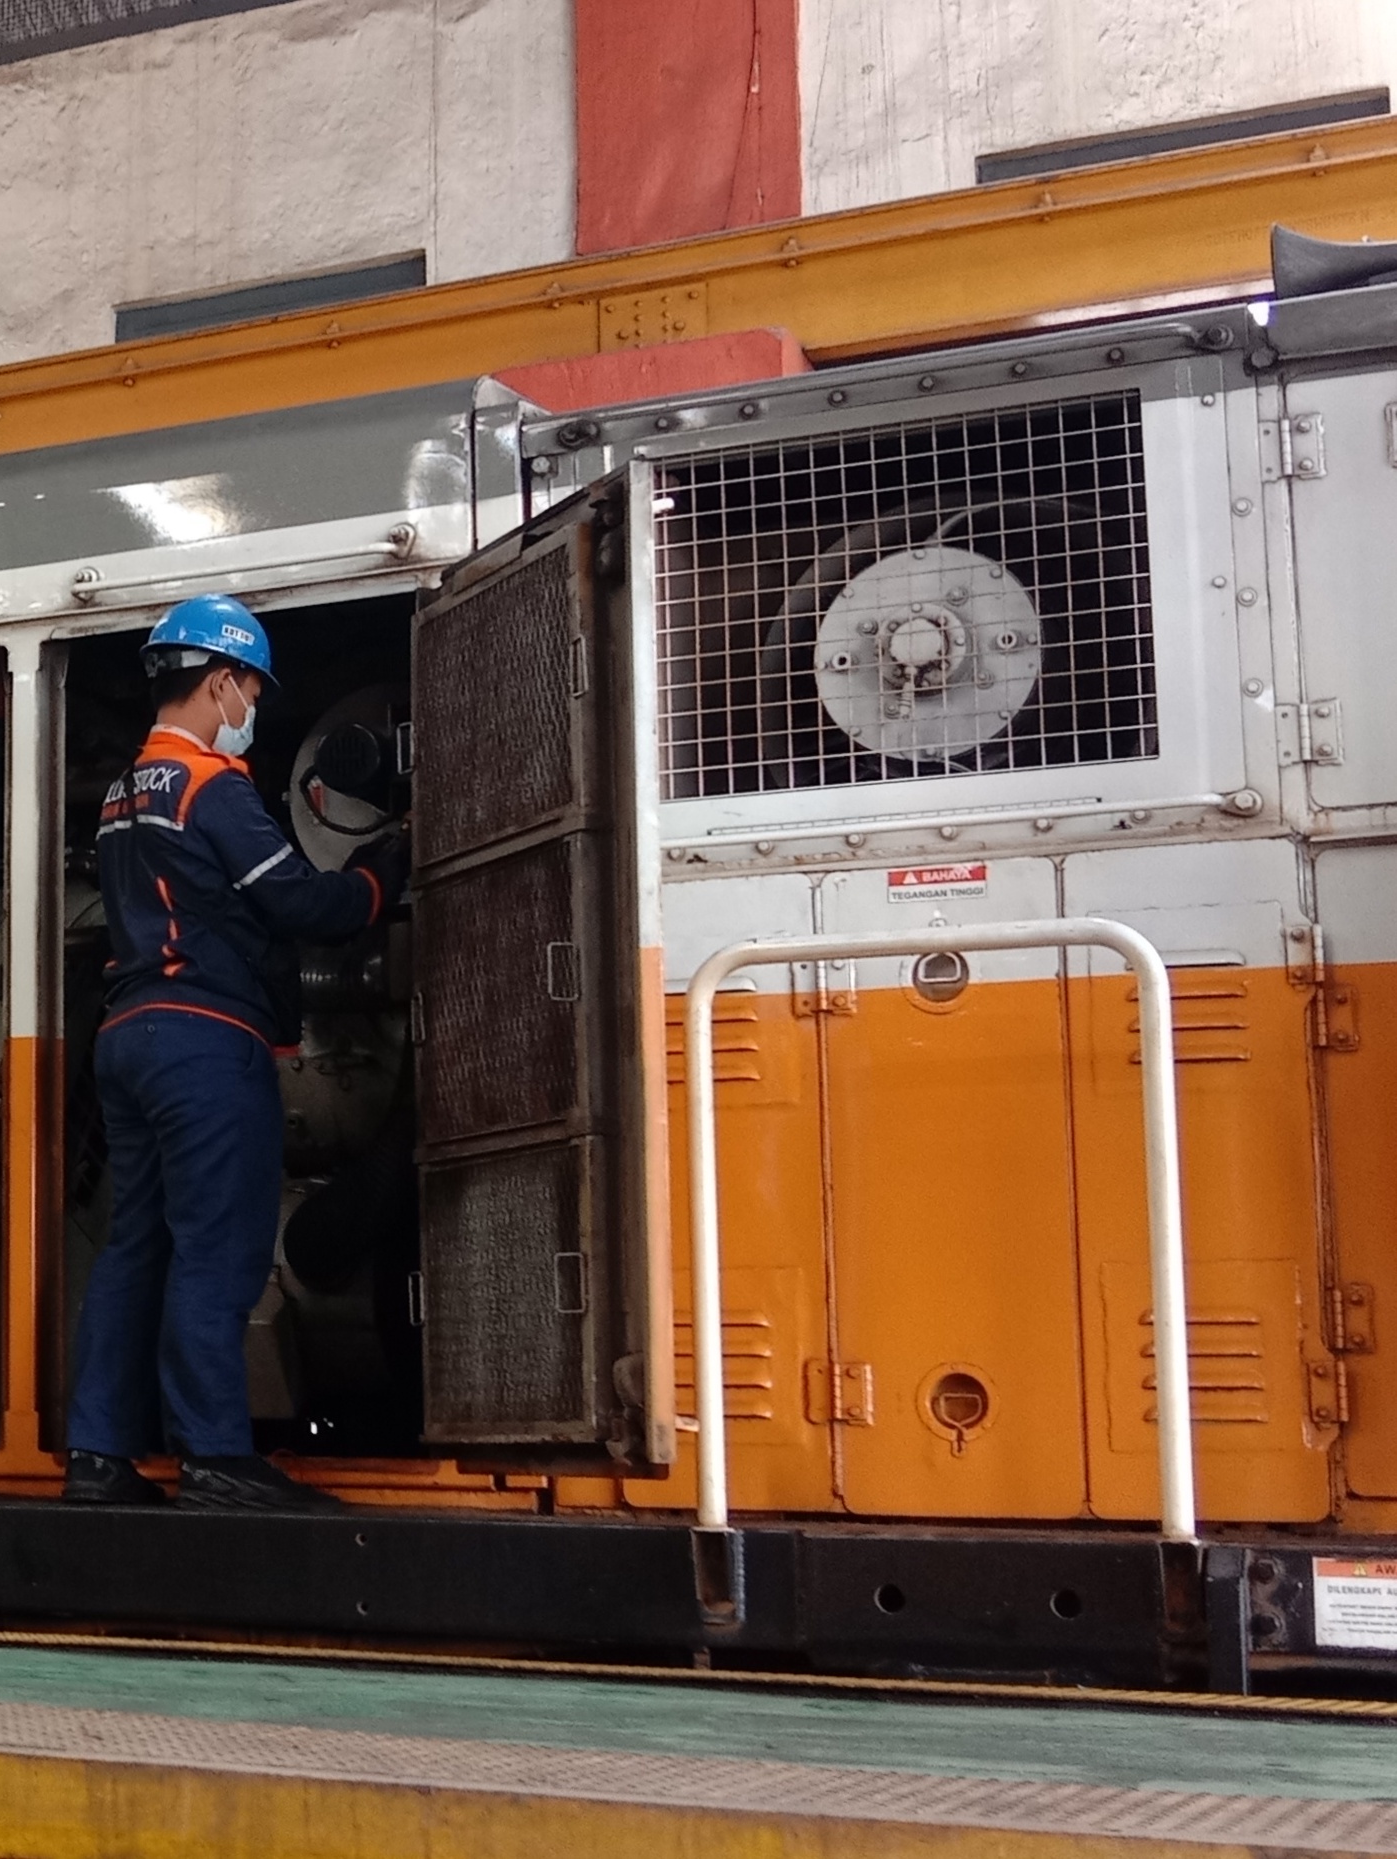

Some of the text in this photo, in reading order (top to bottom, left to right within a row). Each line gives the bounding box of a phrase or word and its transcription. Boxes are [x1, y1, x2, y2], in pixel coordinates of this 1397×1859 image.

[922, 868, 972, 882] BAHAYA
[892, 887, 984, 900] TEGANGAN TINGGI
